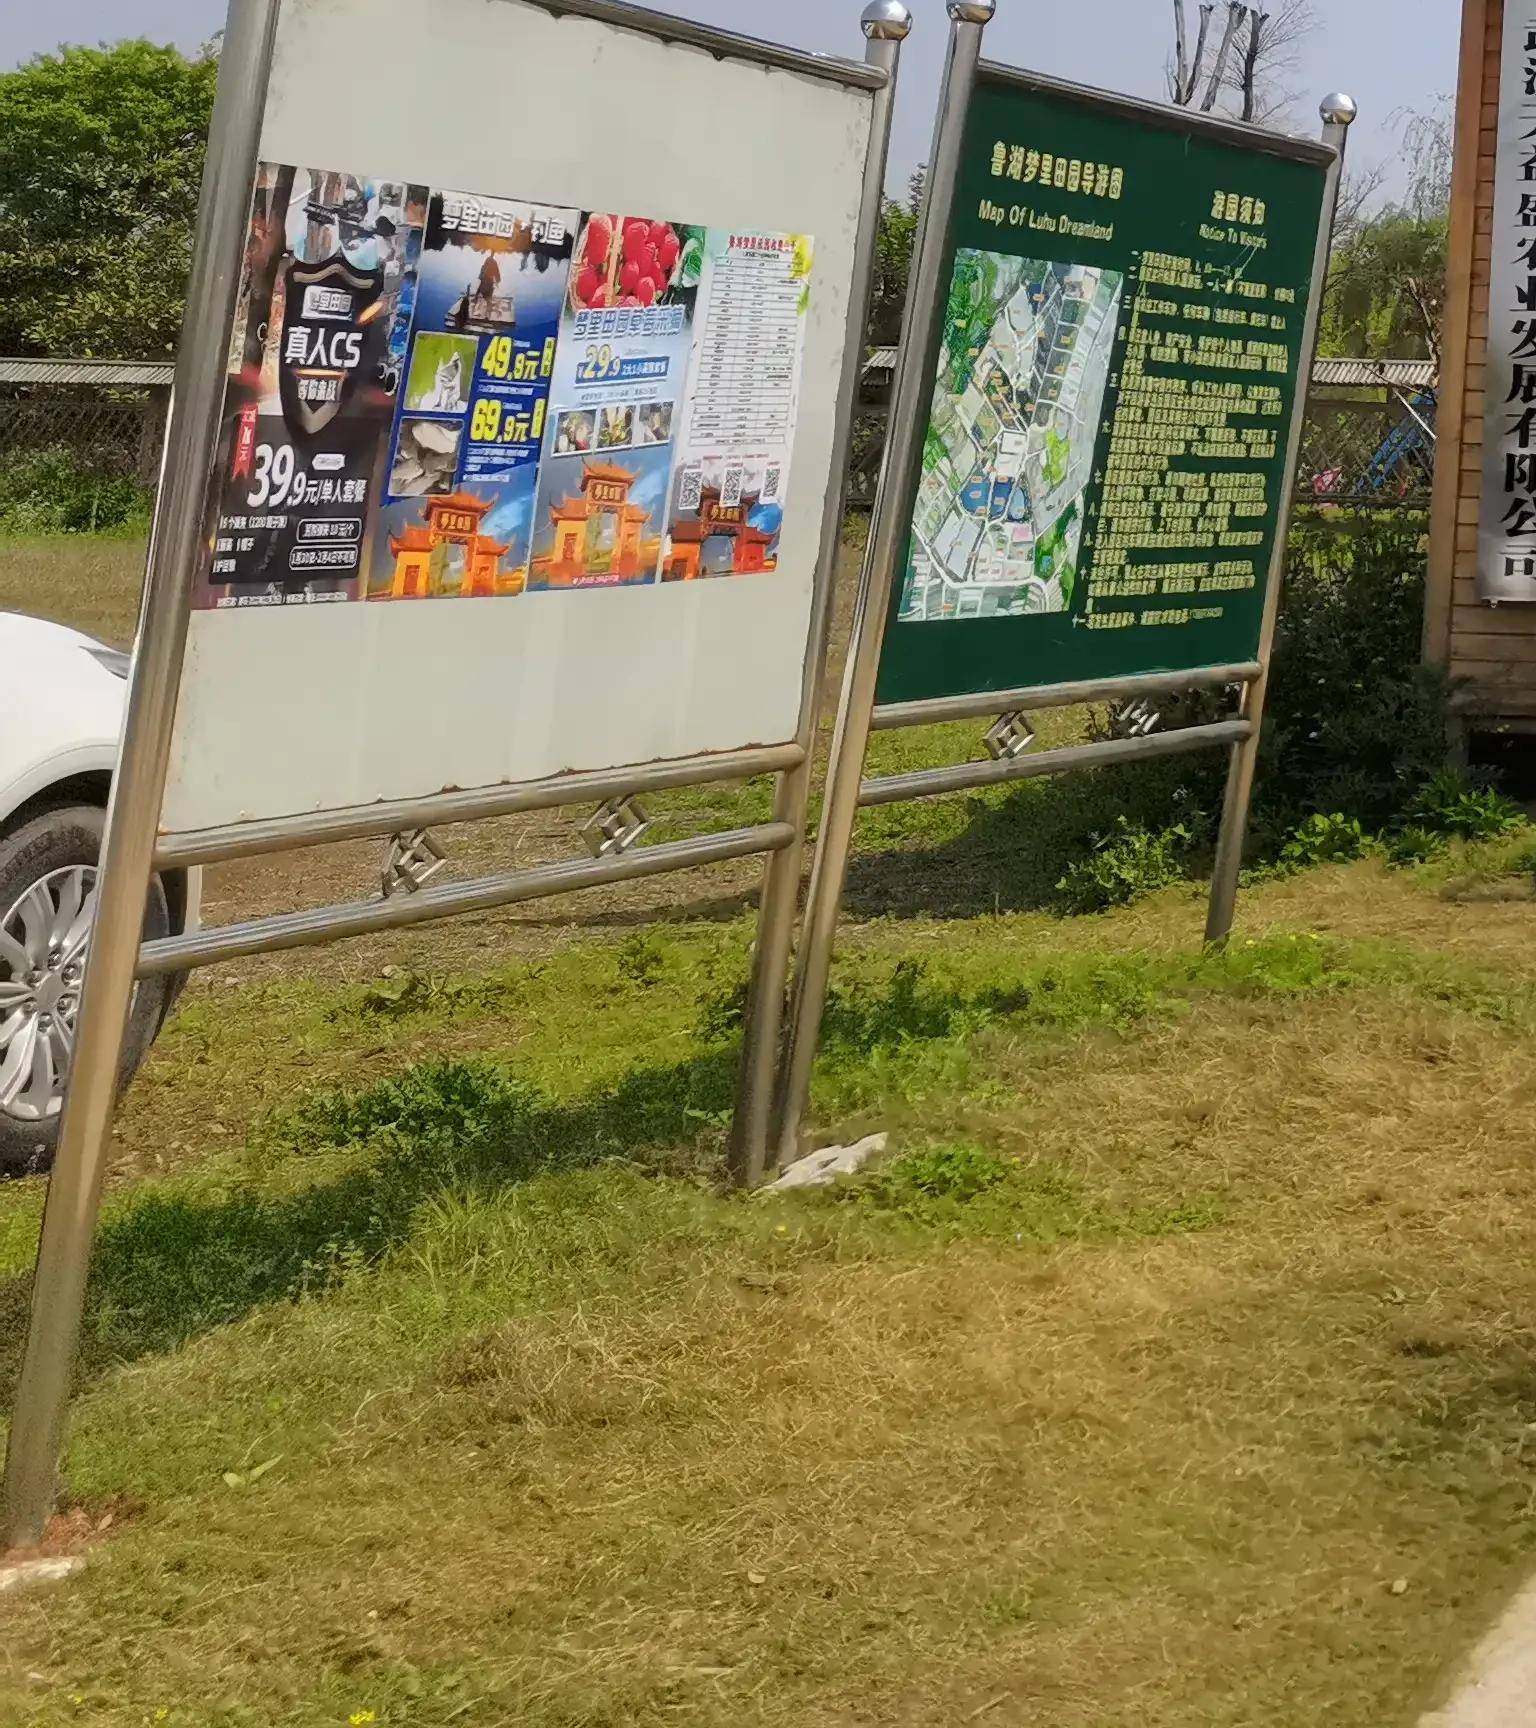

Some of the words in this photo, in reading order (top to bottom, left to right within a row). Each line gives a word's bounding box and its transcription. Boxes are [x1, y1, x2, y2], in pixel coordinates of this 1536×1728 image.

[990, 141, 1124, 200] 鲁湖梦里田园导游图
[978, 199, 1005, 226] Map
[1009, 204, 1027, 226] Of
[1028, 208, 1057, 232] Luhu
[1058, 214, 1114, 242] Dreamland
[1210, 189, 1266, 225] 游园须知
[1227, 227, 1238, 244] To
[285, 325, 363, 369] 真人CS
